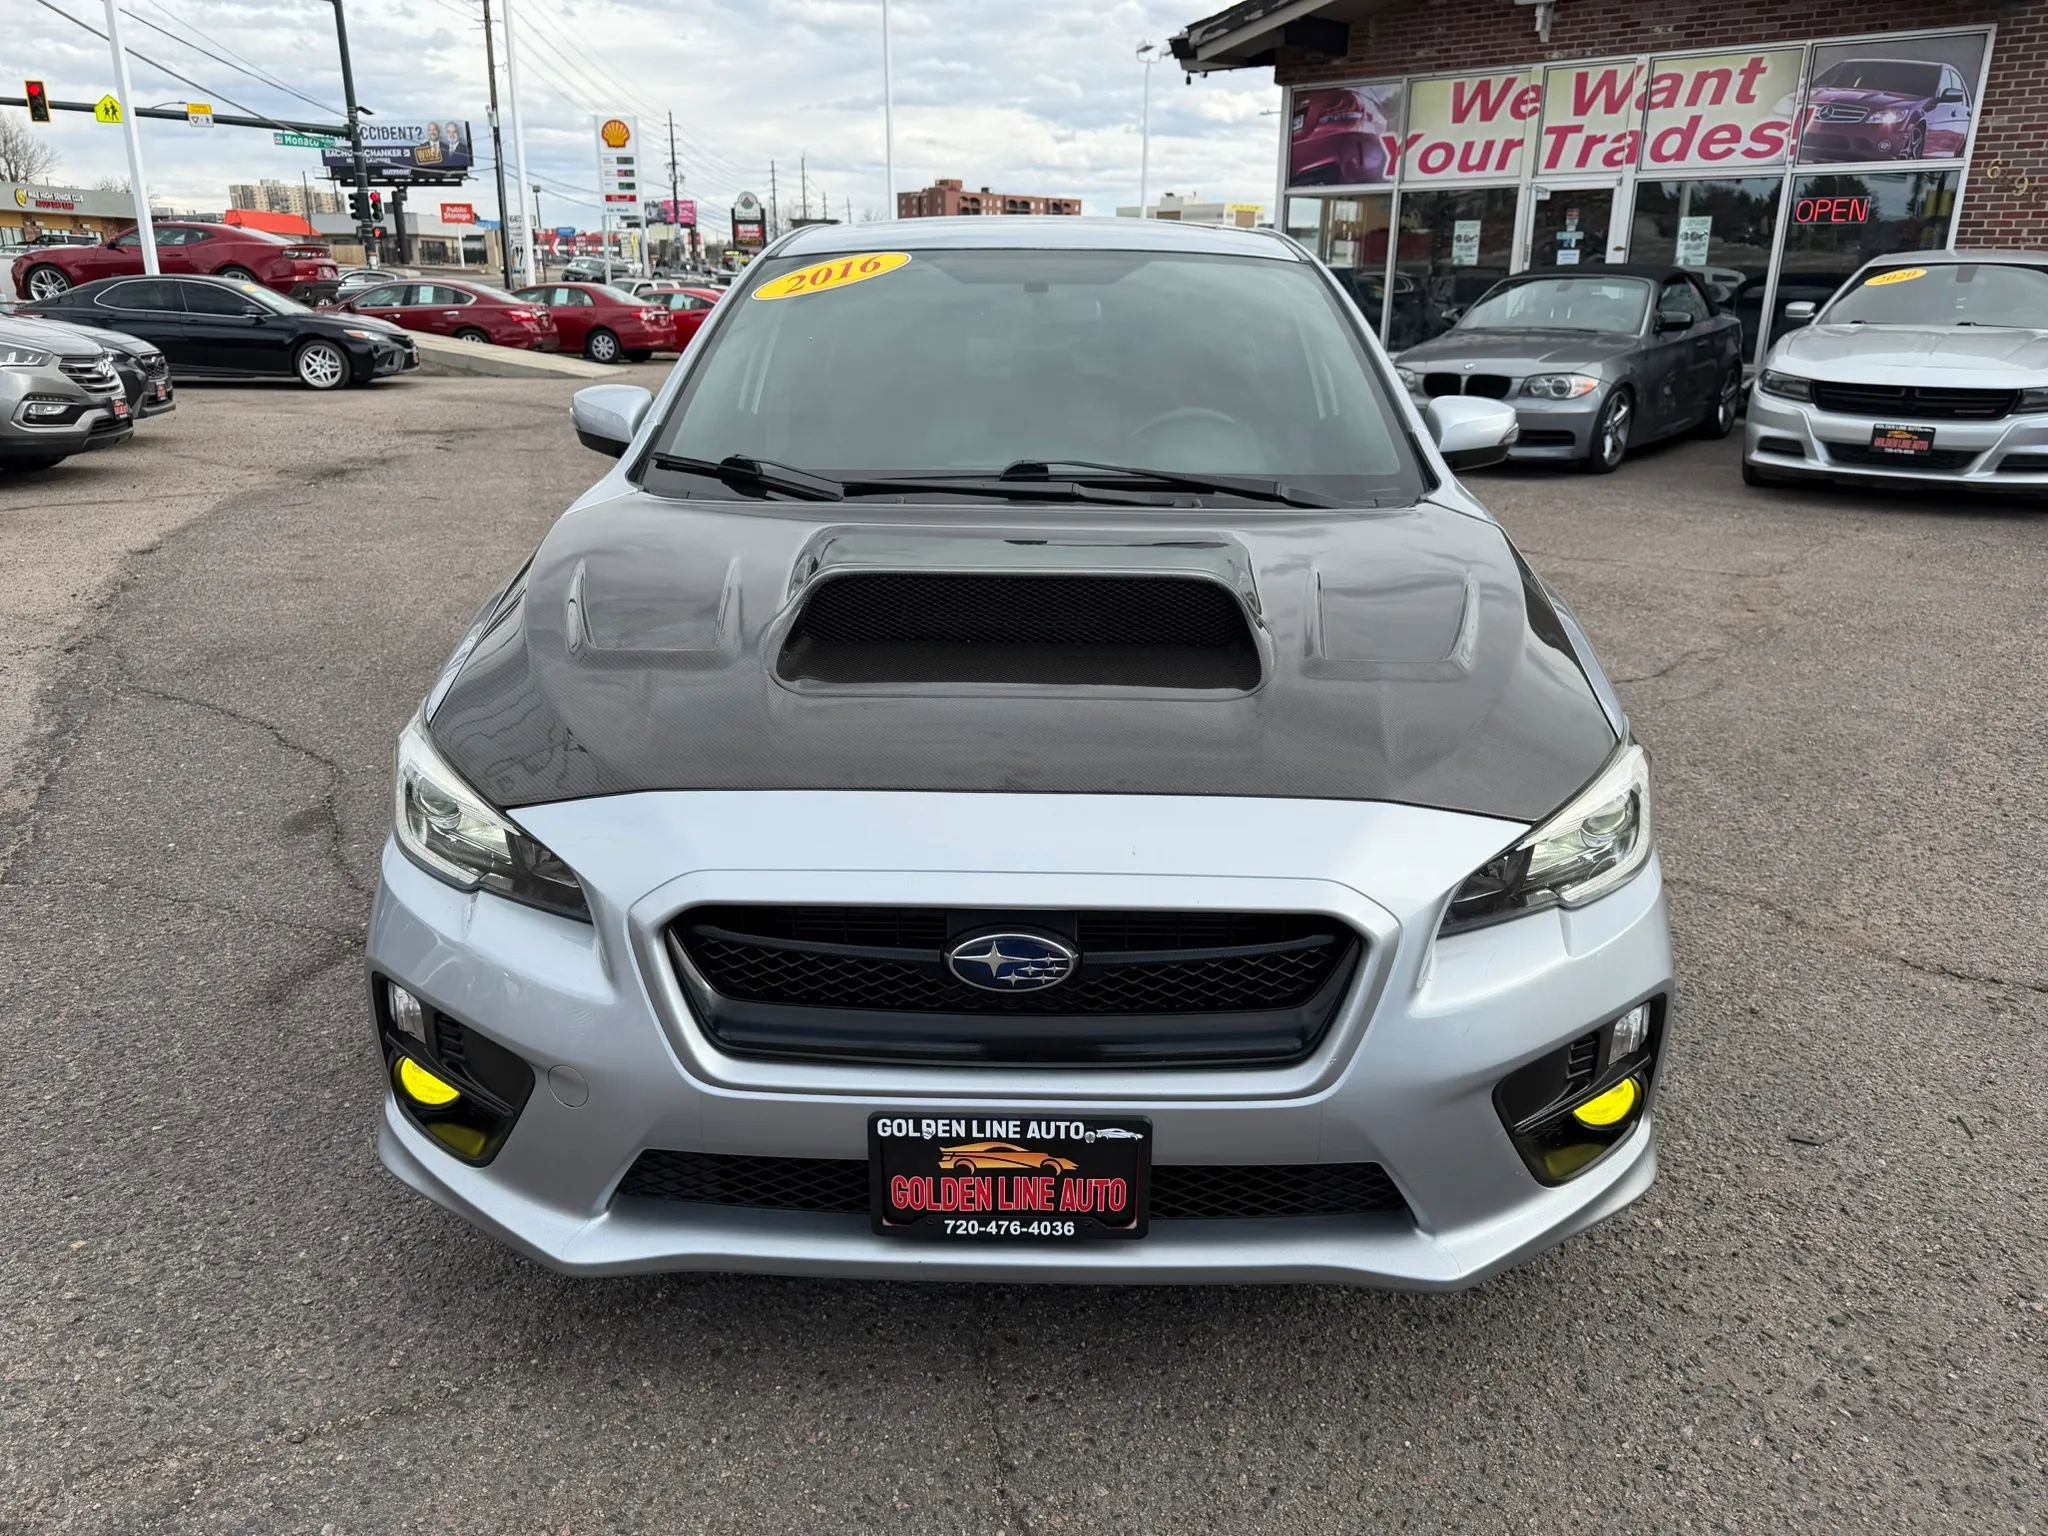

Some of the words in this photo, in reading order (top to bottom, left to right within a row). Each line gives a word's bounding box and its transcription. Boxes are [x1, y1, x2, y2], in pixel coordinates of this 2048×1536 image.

[1451, 76, 1542, 125] We
[1572, 56, 1768, 118] Want
[284, 134, 320, 147] Monaco
[361, 125, 423, 142] CCIDENT?
[1382, 132, 1525, 177] Your
[1543, 107, 1816, 170] Trades!
[361, 147, 402, 158] CHANKER
[1796, 198, 1869, 222] OPEN
[784, 254, 883, 295] 2016
[877, 1118, 966, 1139] GOLDEN
[972, 1120, 1021, 1139] LINE
[1027, 1120, 1085, 1140] AUTO
[891, 1174, 992, 1211] GOLDEN
[998, 1176, 1055, 1211] LINE
[1060, 1177, 1127, 1212] AUTO
[944, 1220, 1075, 1236] 720-476-4036
